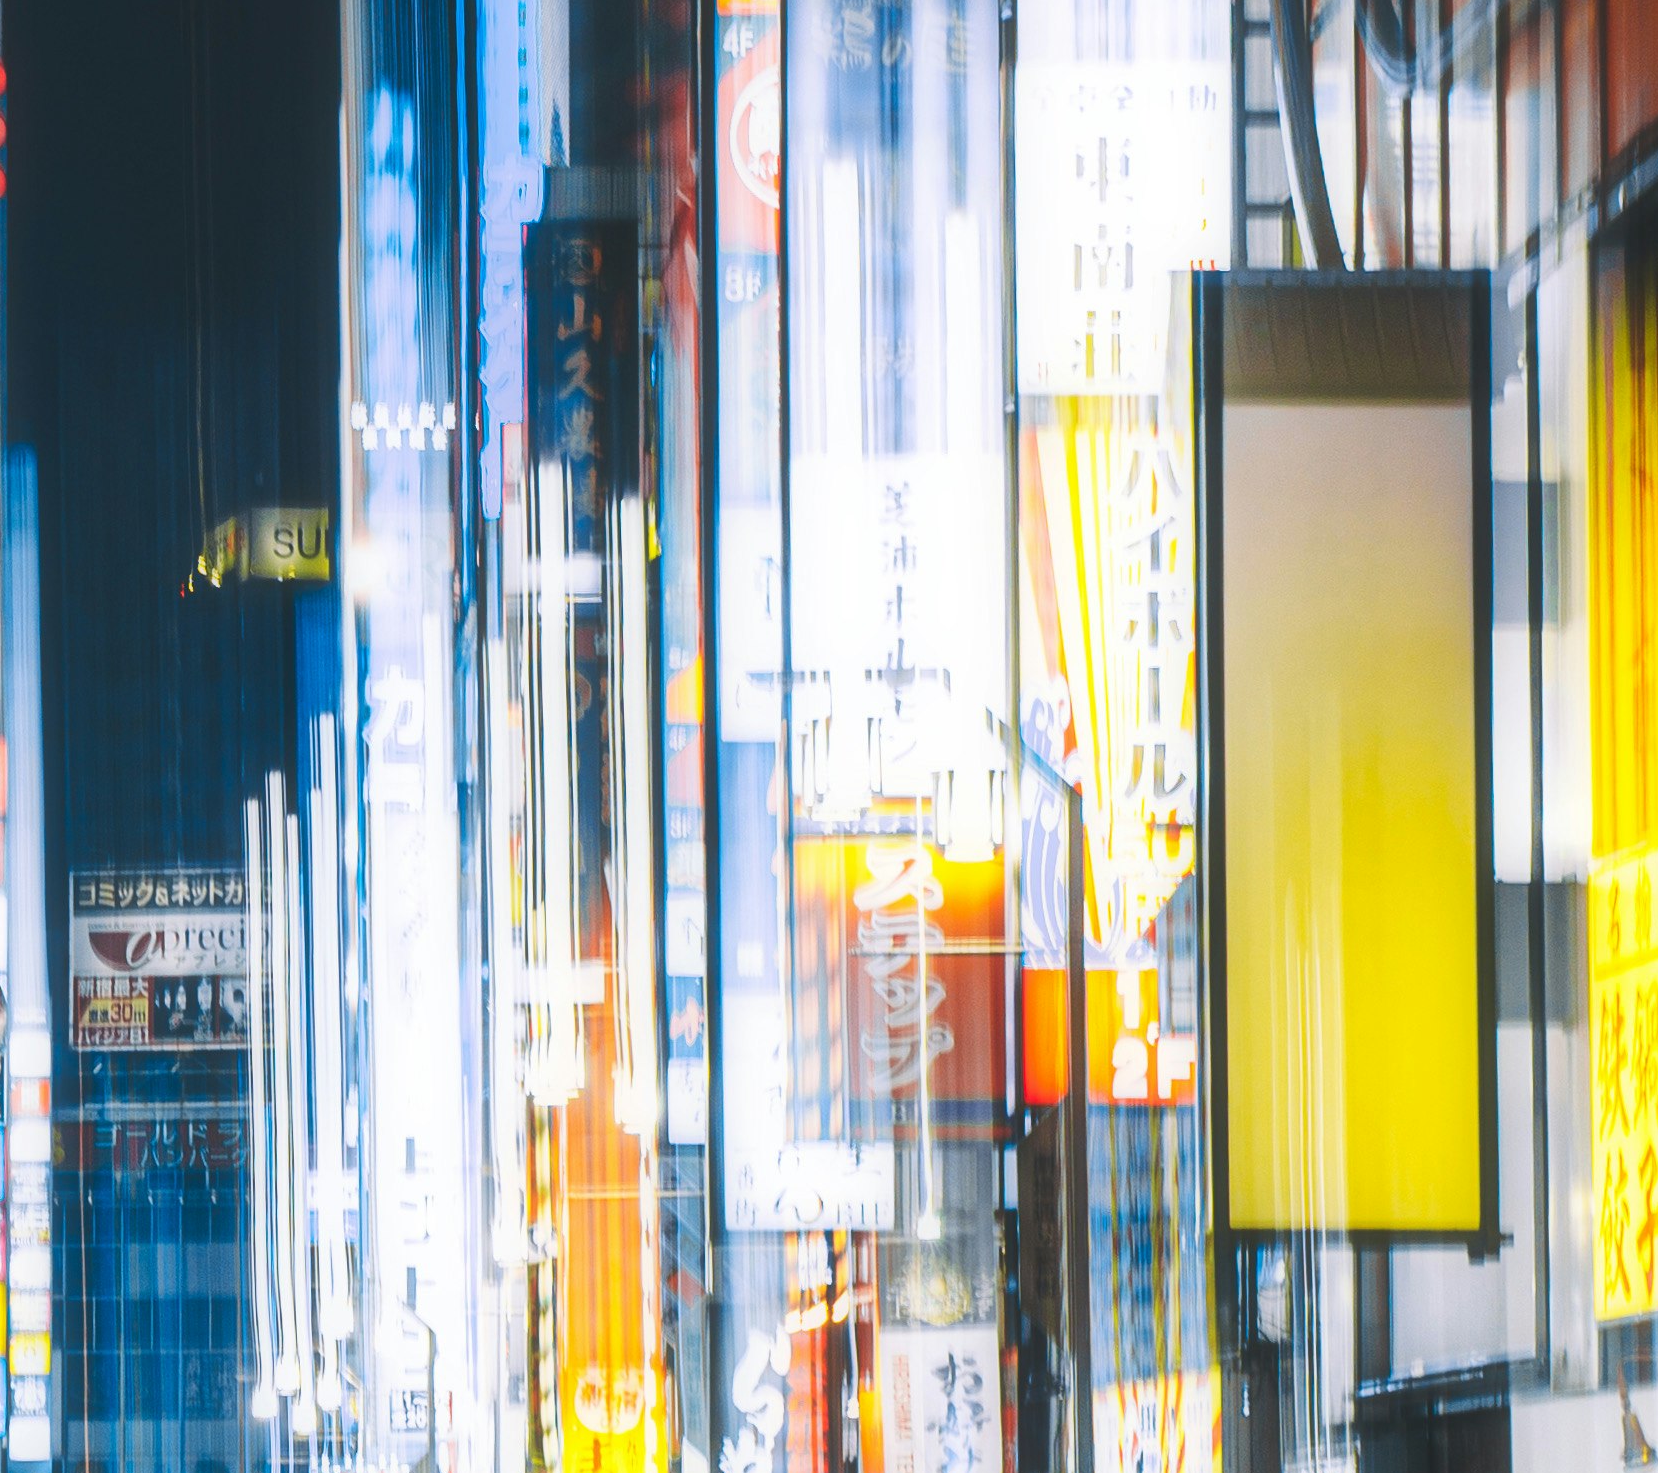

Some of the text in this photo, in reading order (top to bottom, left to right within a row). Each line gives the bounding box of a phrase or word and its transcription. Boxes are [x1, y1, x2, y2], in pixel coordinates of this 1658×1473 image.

[723, 21, 754, 60] 4F
[271, 523, 329, 562] SU
[1122, 448, 1187, 799] ハイボール
[79, 877, 244, 908] コミック&ネットカ
[127, 920, 245, 968] apreci
[94, 1122, 243, 1149] ゴールドラ
